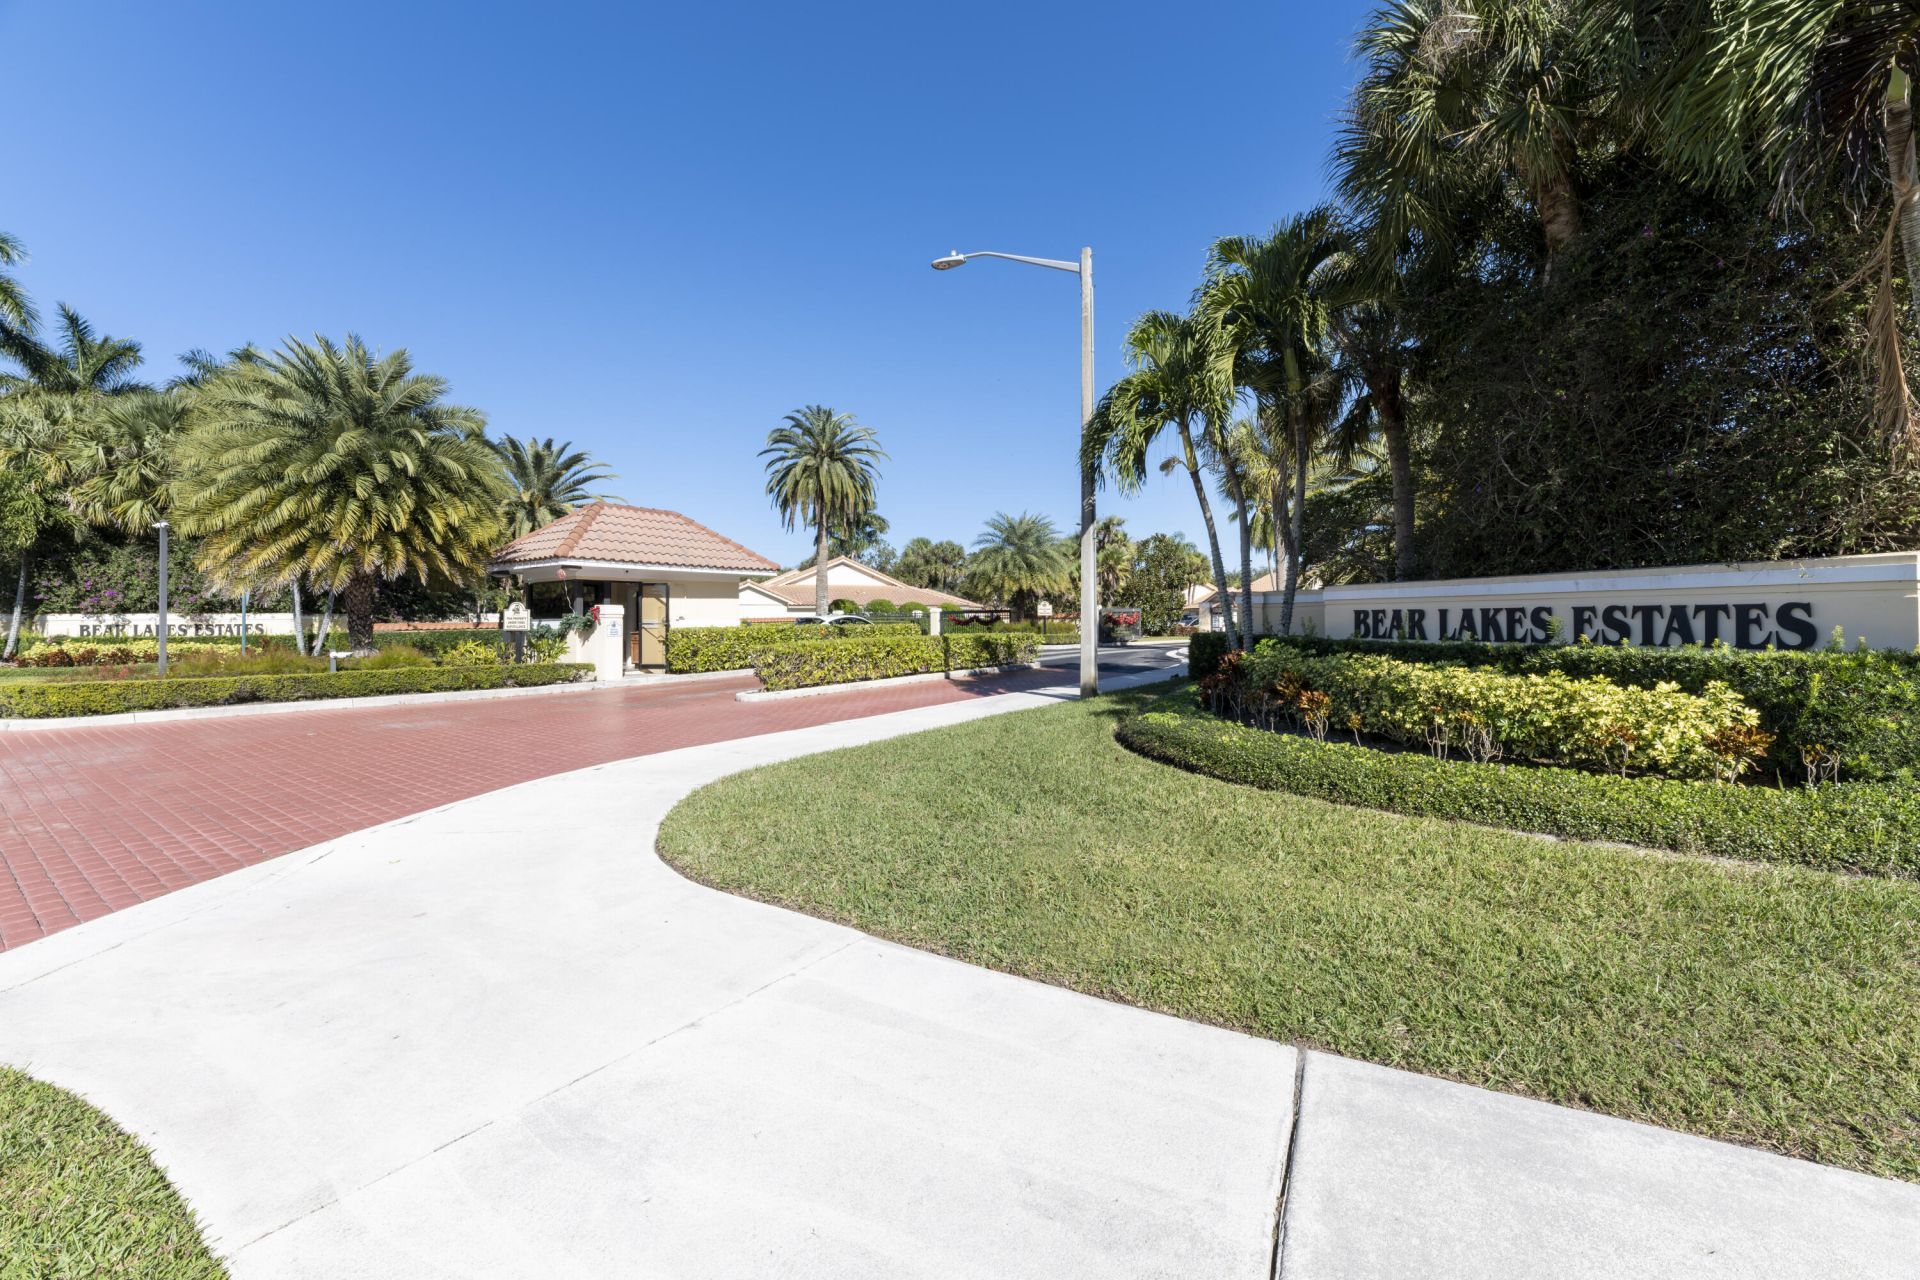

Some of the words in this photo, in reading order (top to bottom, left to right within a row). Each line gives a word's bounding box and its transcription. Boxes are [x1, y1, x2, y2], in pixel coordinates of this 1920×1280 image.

[79, 624, 127, 637] BEAR
[1353, 609, 1428, 640] BEAR
[1438, 606, 1553, 643] LAKES
[1571, 602, 1818, 650] ESTATES
